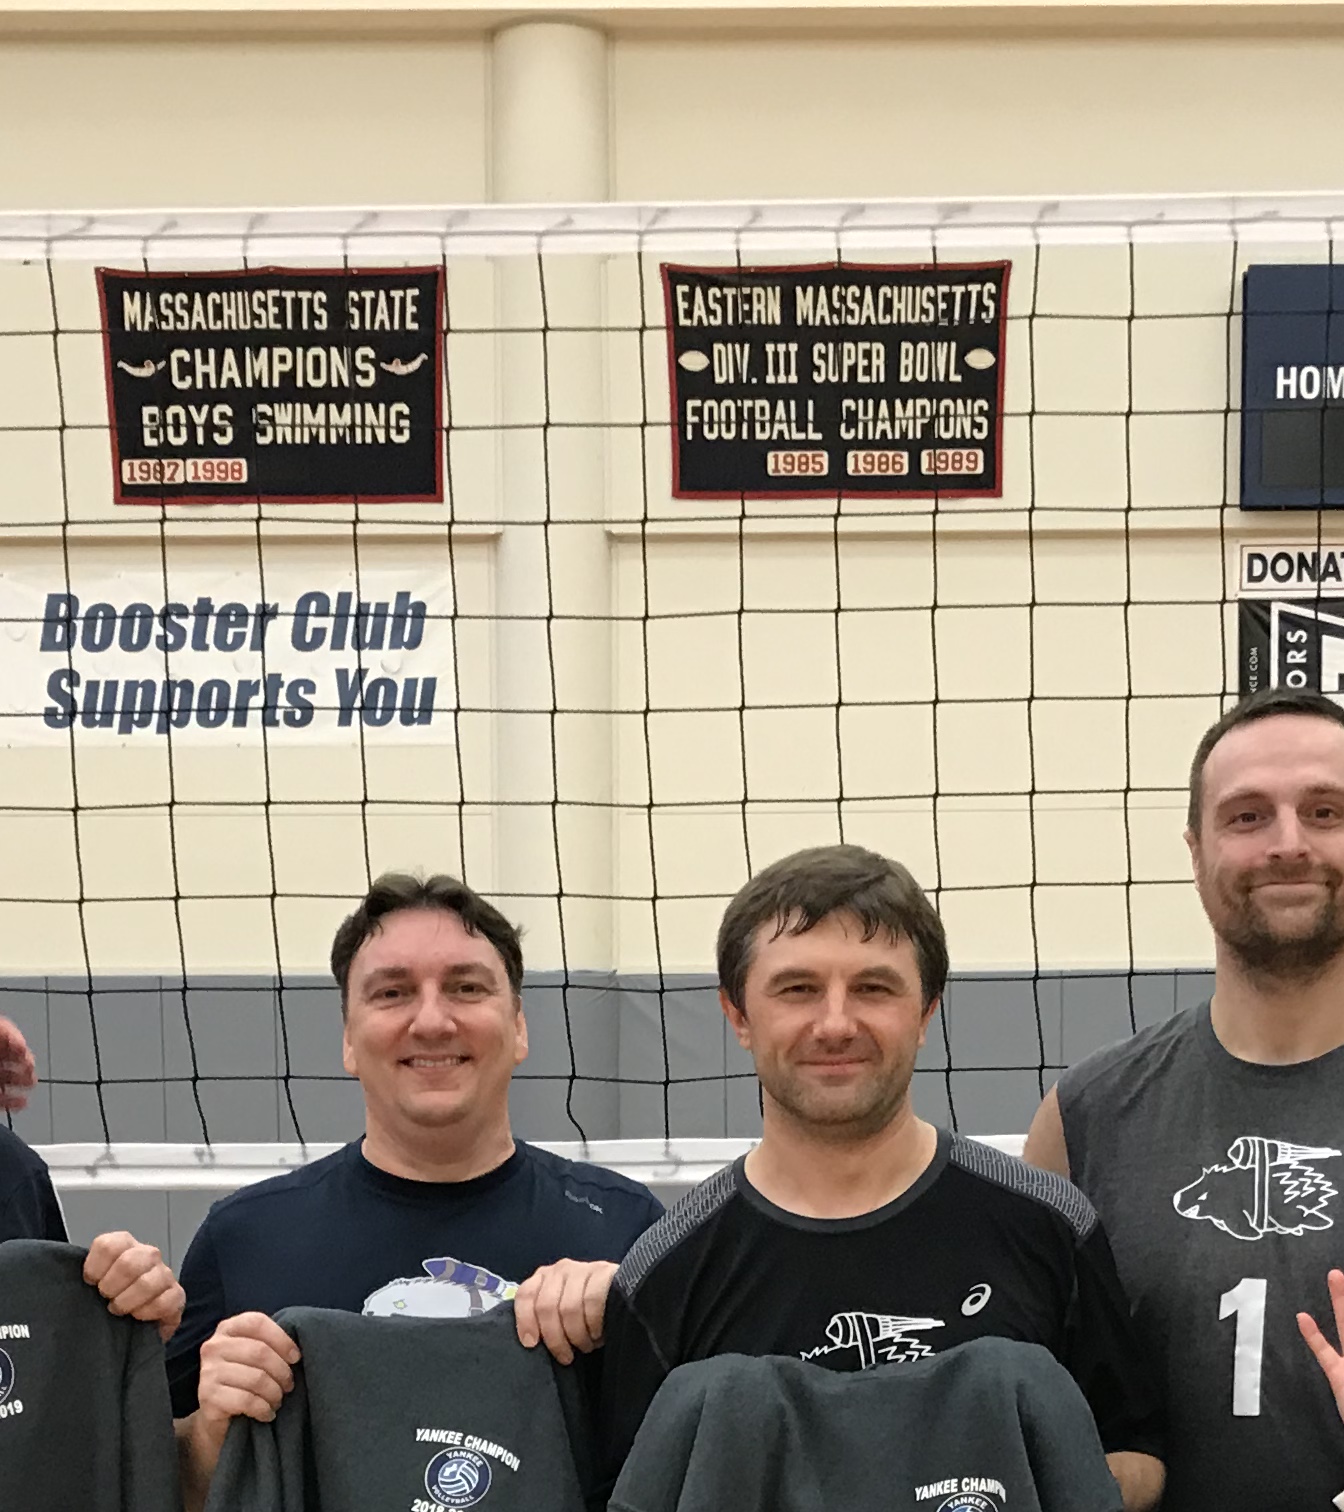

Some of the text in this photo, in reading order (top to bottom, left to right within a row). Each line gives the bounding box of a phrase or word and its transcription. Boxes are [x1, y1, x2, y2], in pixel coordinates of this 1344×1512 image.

[123, 287, 420, 332] MASSACHUSETTS STATE
[675, 282, 997, 327] EASTERN MASSACHUSETTS
[170, 346, 376, 390] CHAMPIONS
[712, 341, 962, 384] DIV. III SUPER BOWL
[142, 402, 411, 447] BOYS SWIMMING
[685, 398, 989, 441] FOOTBALL CHAMPIONS
[126, 461, 244, 482] 1987 1998
[771, 452, 979, 475] 1985 1986 1989
[39, 591, 428, 654] Booster Club
[43, 668, 439, 736] Supports You
[1219, 1278, 1267, 1416] 1
[416, 1428, 520, 1472] YANKEE CHAMPION
[446, 1451, 483, 1467] YANKEE
[431, 1485, 474, 1504] VOLLEYBALL
[915, 1478, 958, 1501] YANKEE
[947, 1496, 988, 1509] YANKEE
